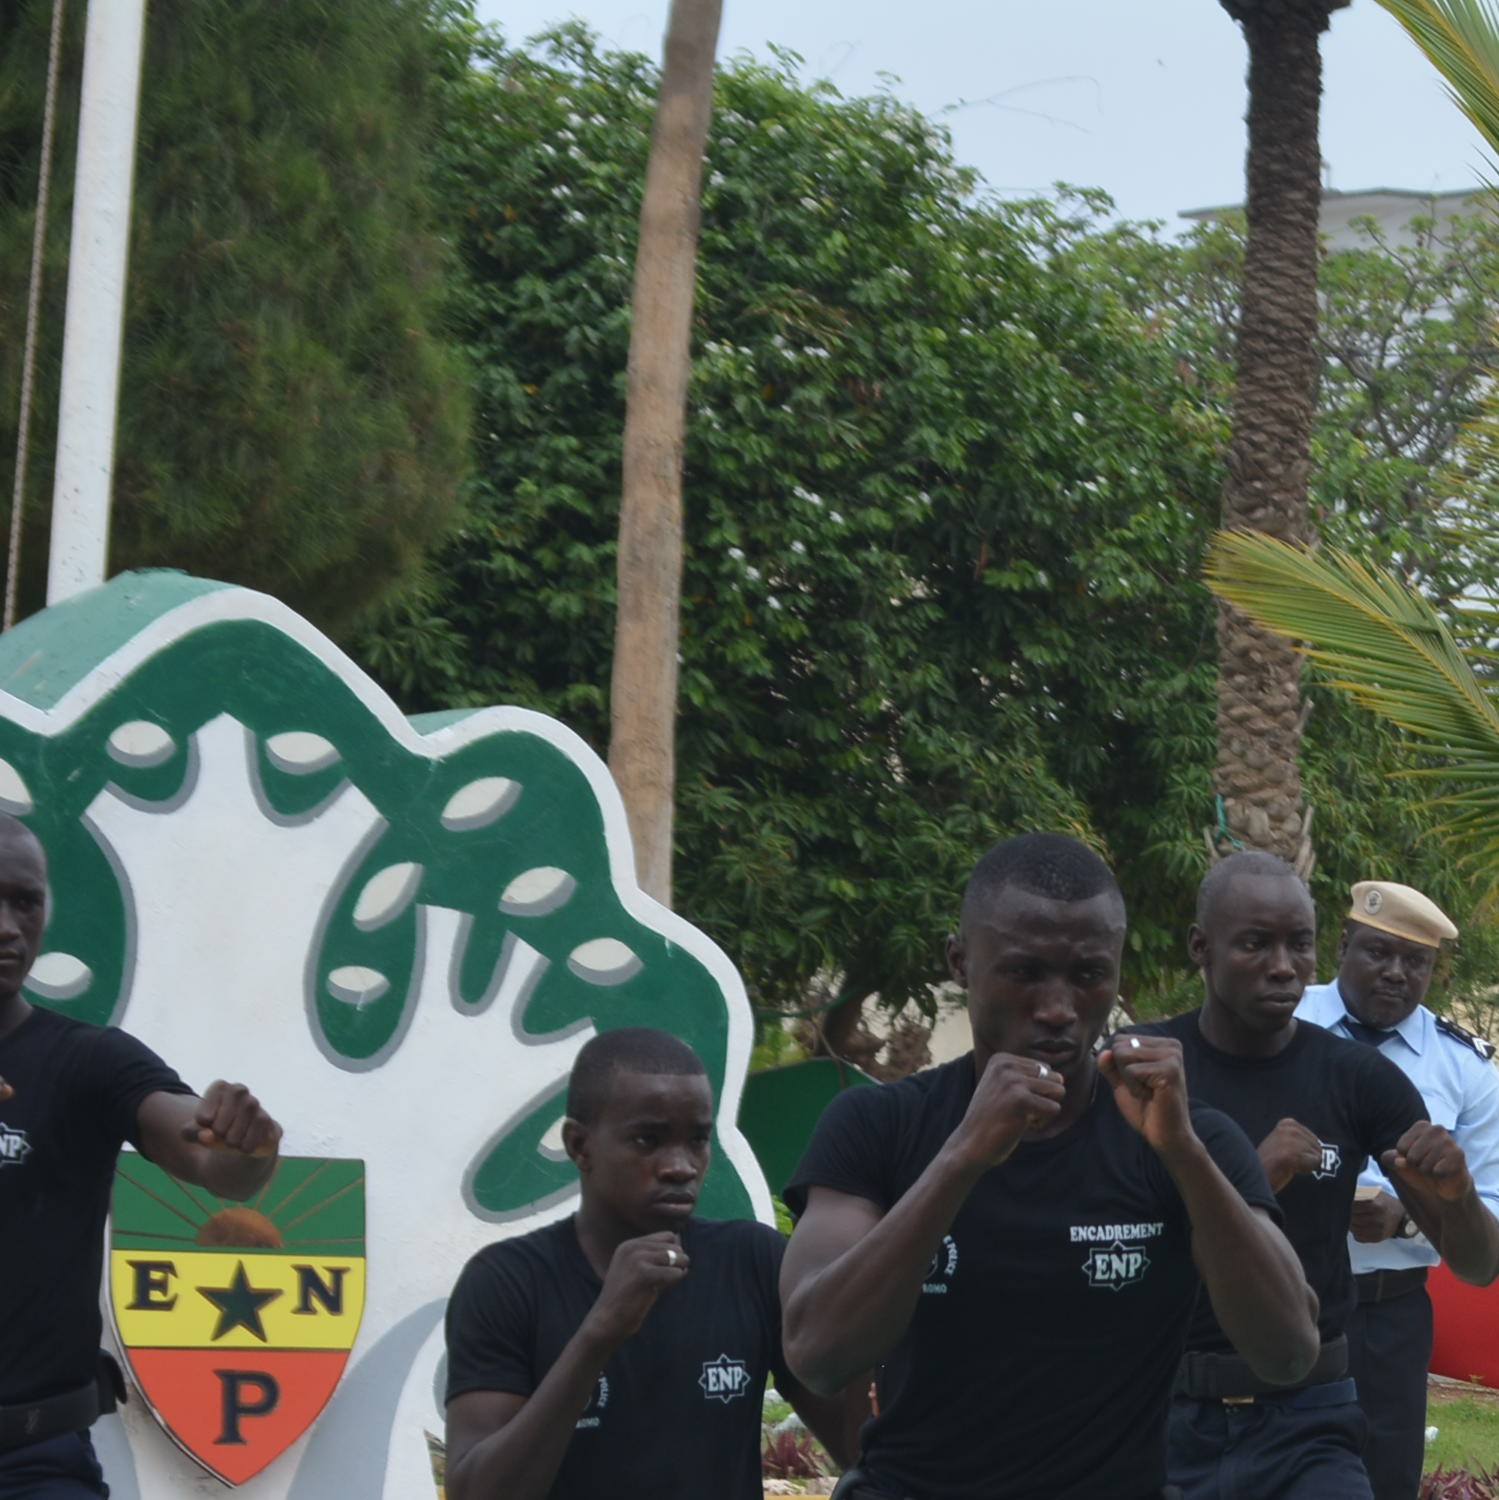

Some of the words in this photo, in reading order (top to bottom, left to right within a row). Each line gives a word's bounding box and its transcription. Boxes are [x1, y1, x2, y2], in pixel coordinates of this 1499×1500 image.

[0, 1134, 22, 1158] NP
[1070, 1222, 1164, 1242] ENCADREMENT
[1094, 1252, 1142, 1280] ENP
[125, 1260, 178, 1311] E
[291, 1264, 351, 1316] N
[922, 1283, 947, 1294] ROMO
[707, 1365, 743, 1392] ENP
[212, 1369, 280, 1445] P
